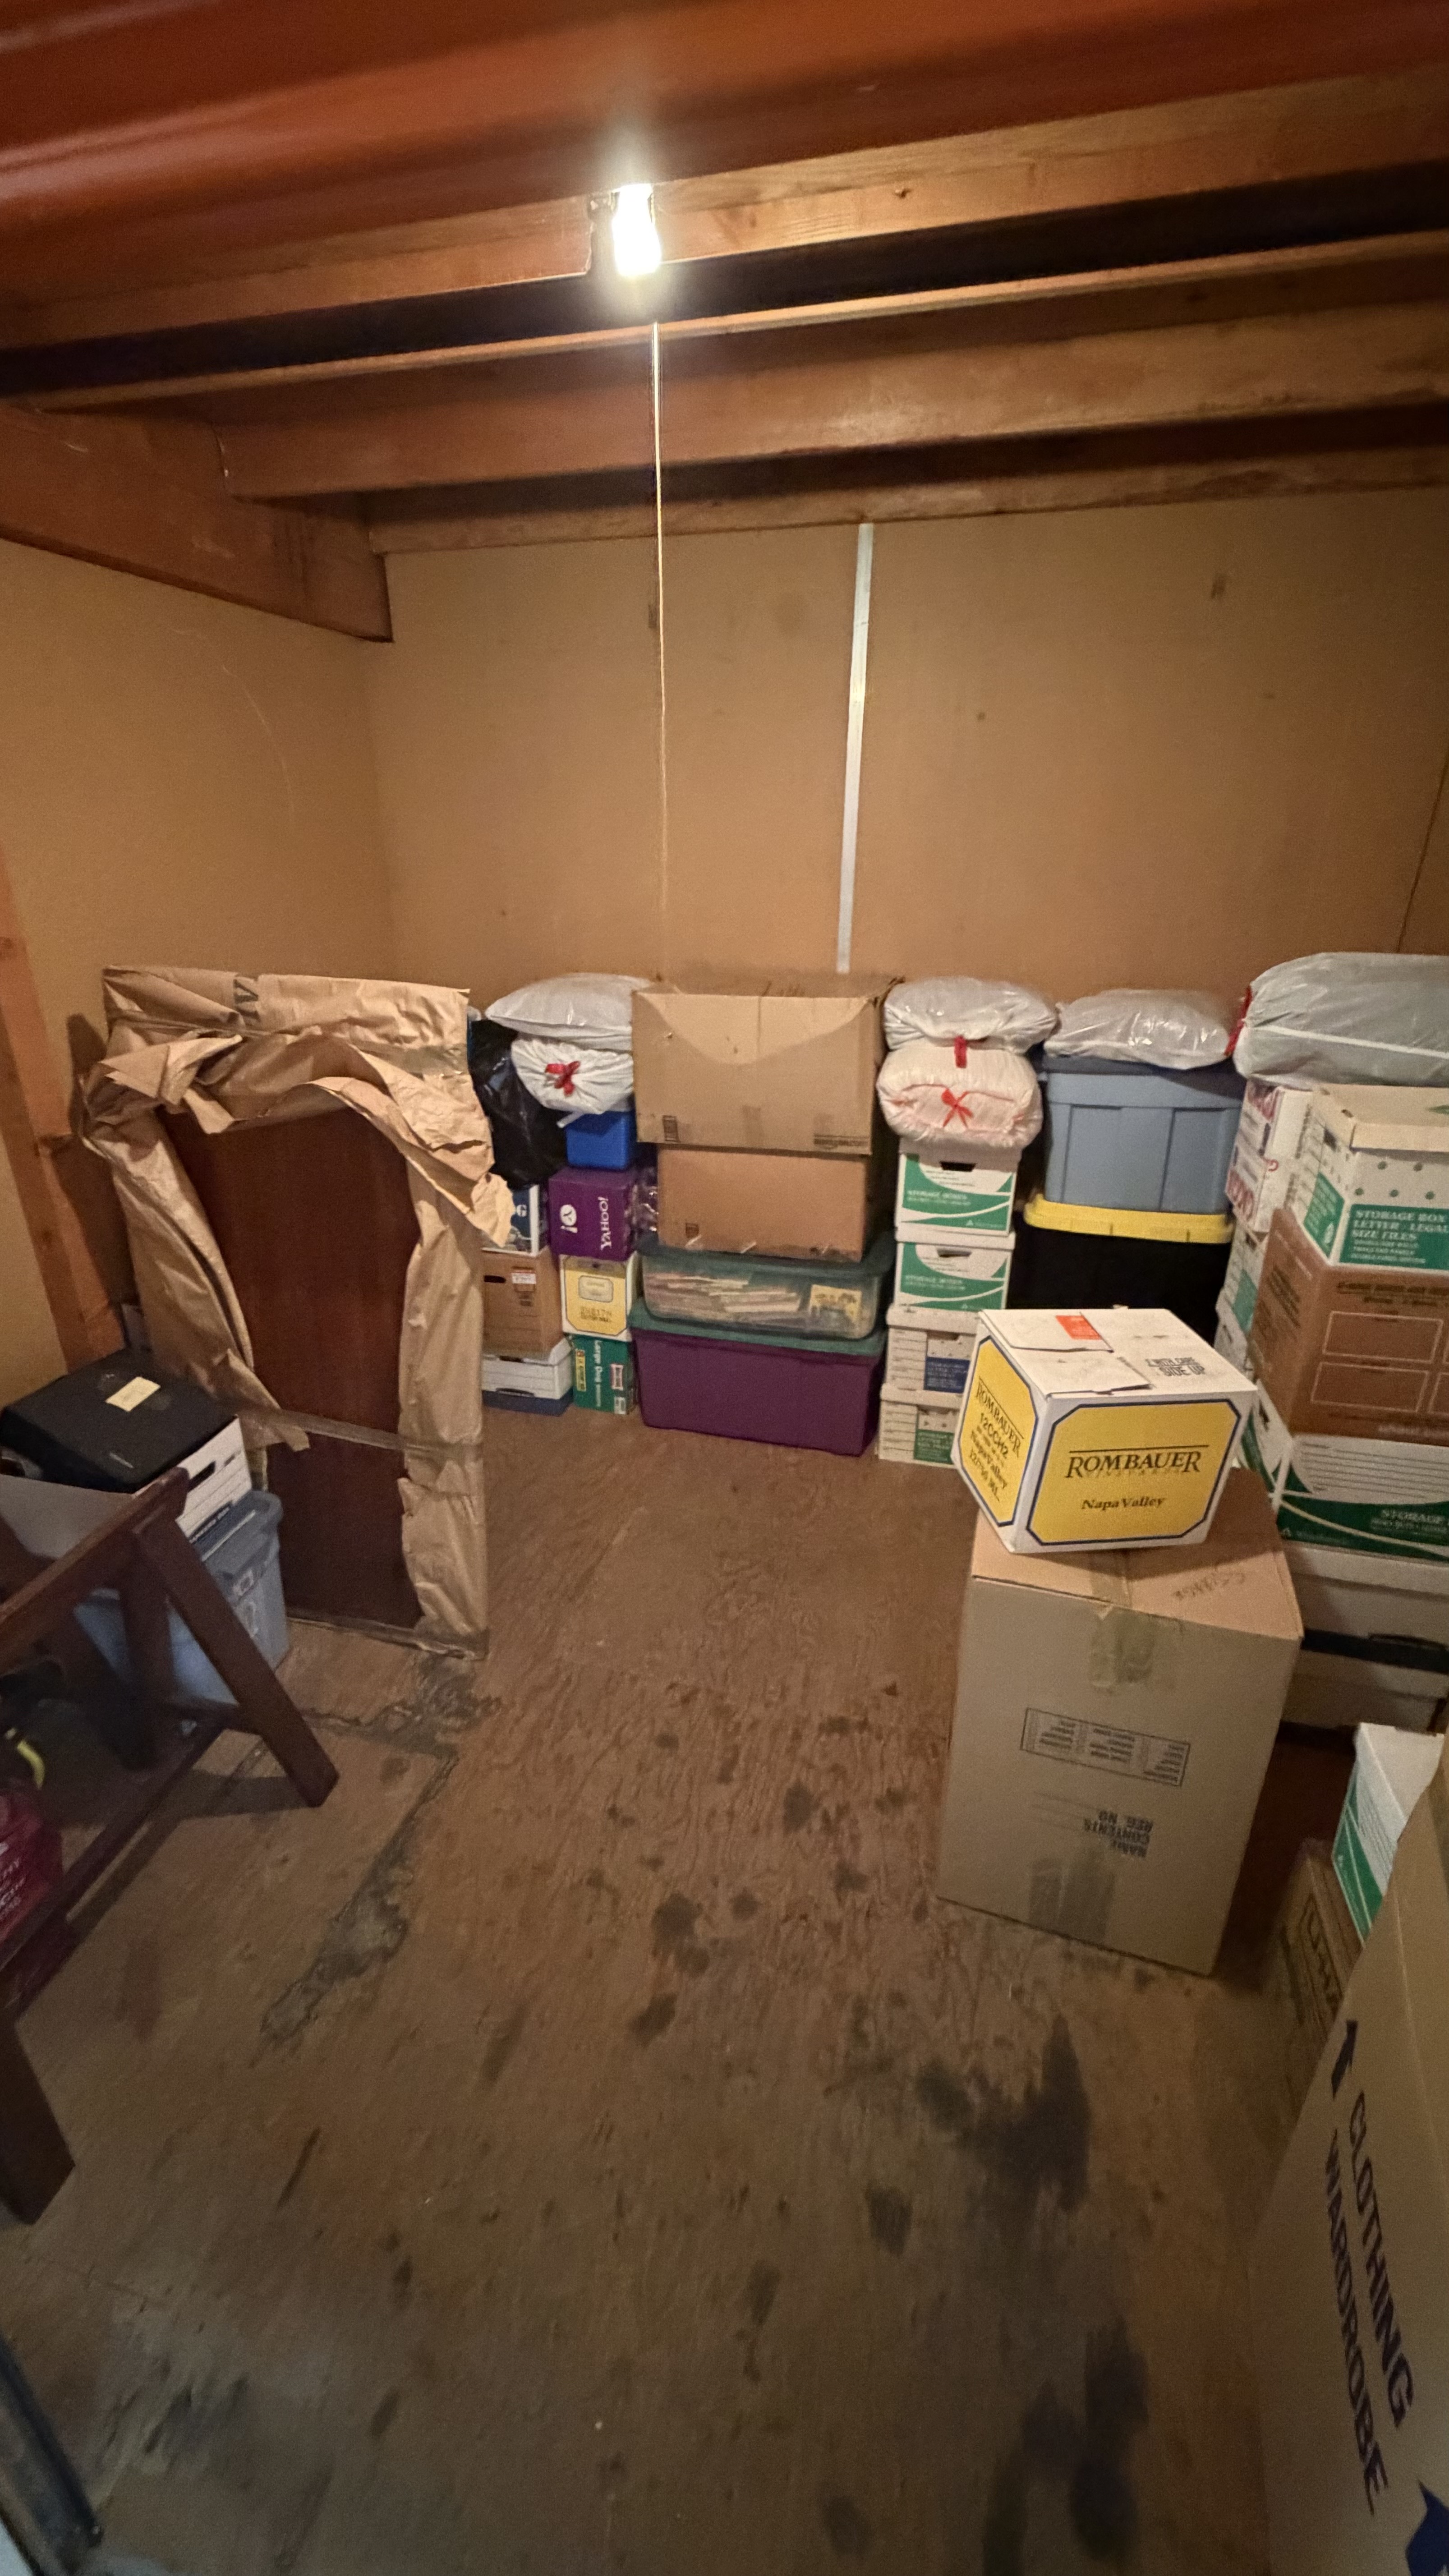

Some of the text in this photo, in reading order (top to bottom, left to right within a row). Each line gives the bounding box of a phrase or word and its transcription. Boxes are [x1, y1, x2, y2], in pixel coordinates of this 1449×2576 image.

[598, 1196, 612, 1251] YAHOO!
[1353, 1219, 1400, 1229] LETTER
[1356, 1209, 1416, 1220] STORAGE
[1352, 1229, 1417, 1241] SIZE FILES
[975, 1381, 1021, 1458] ROMBAUER
[1065, 1451, 1202, 1478] ROMBAUER
[1081, 1496, 1166, 1511] Napa Valley
[1350, 2090, 1414, 2428] CLOTHING
[1325, 2128, 1389, 2516] WARDROBE
